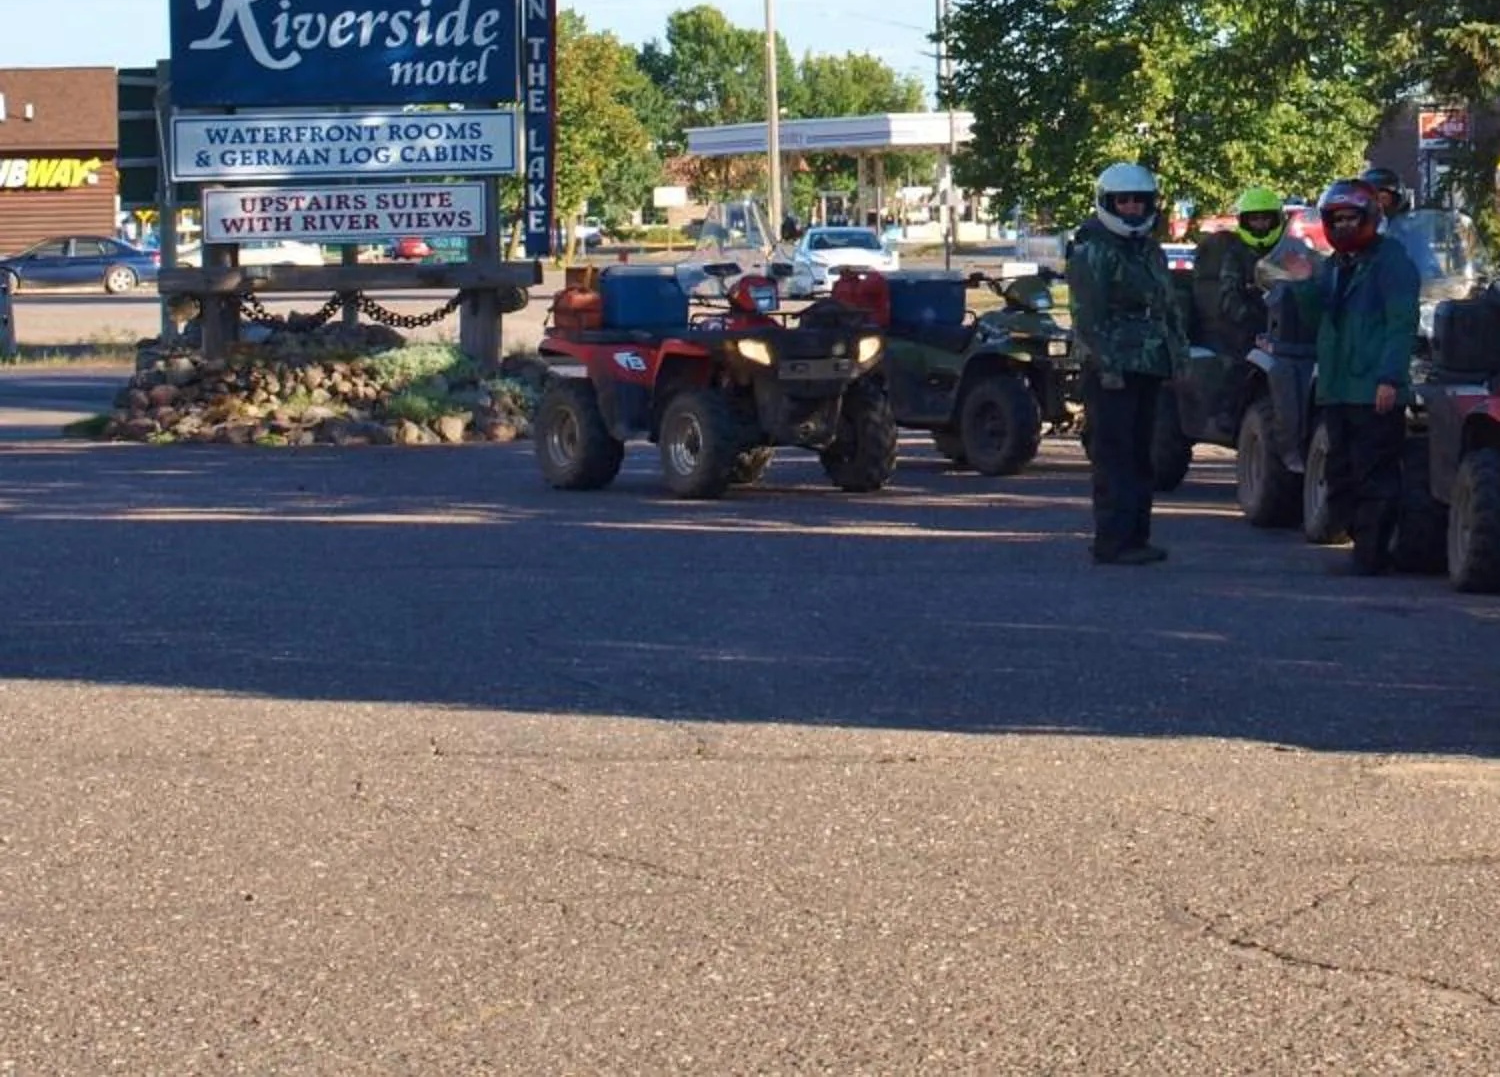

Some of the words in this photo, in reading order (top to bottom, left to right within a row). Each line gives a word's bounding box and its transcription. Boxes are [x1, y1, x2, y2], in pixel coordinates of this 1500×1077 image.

[389, 44, 497, 86] motel
[527, 37, 547, 113] THE
[204, 124, 379, 146] WATERFRONT
[388, 122, 482, 141] ROOMS
[195, 150, 210, 167] &
[219, 147, 331, 166] GERMAN
[338, 145, 391, 164] LOG
[400, 143, 494, 162] CABINS
[527, 127, 547, 233] LAKE
[240, 195, 367, 214] UPSTAIRS
[375, 192, 453, 209] SUITE
[220, 216, 292, 234] WITH
[300, 213, 380, 231] RIVER
[387, 210, 472, 228] VIEWS
